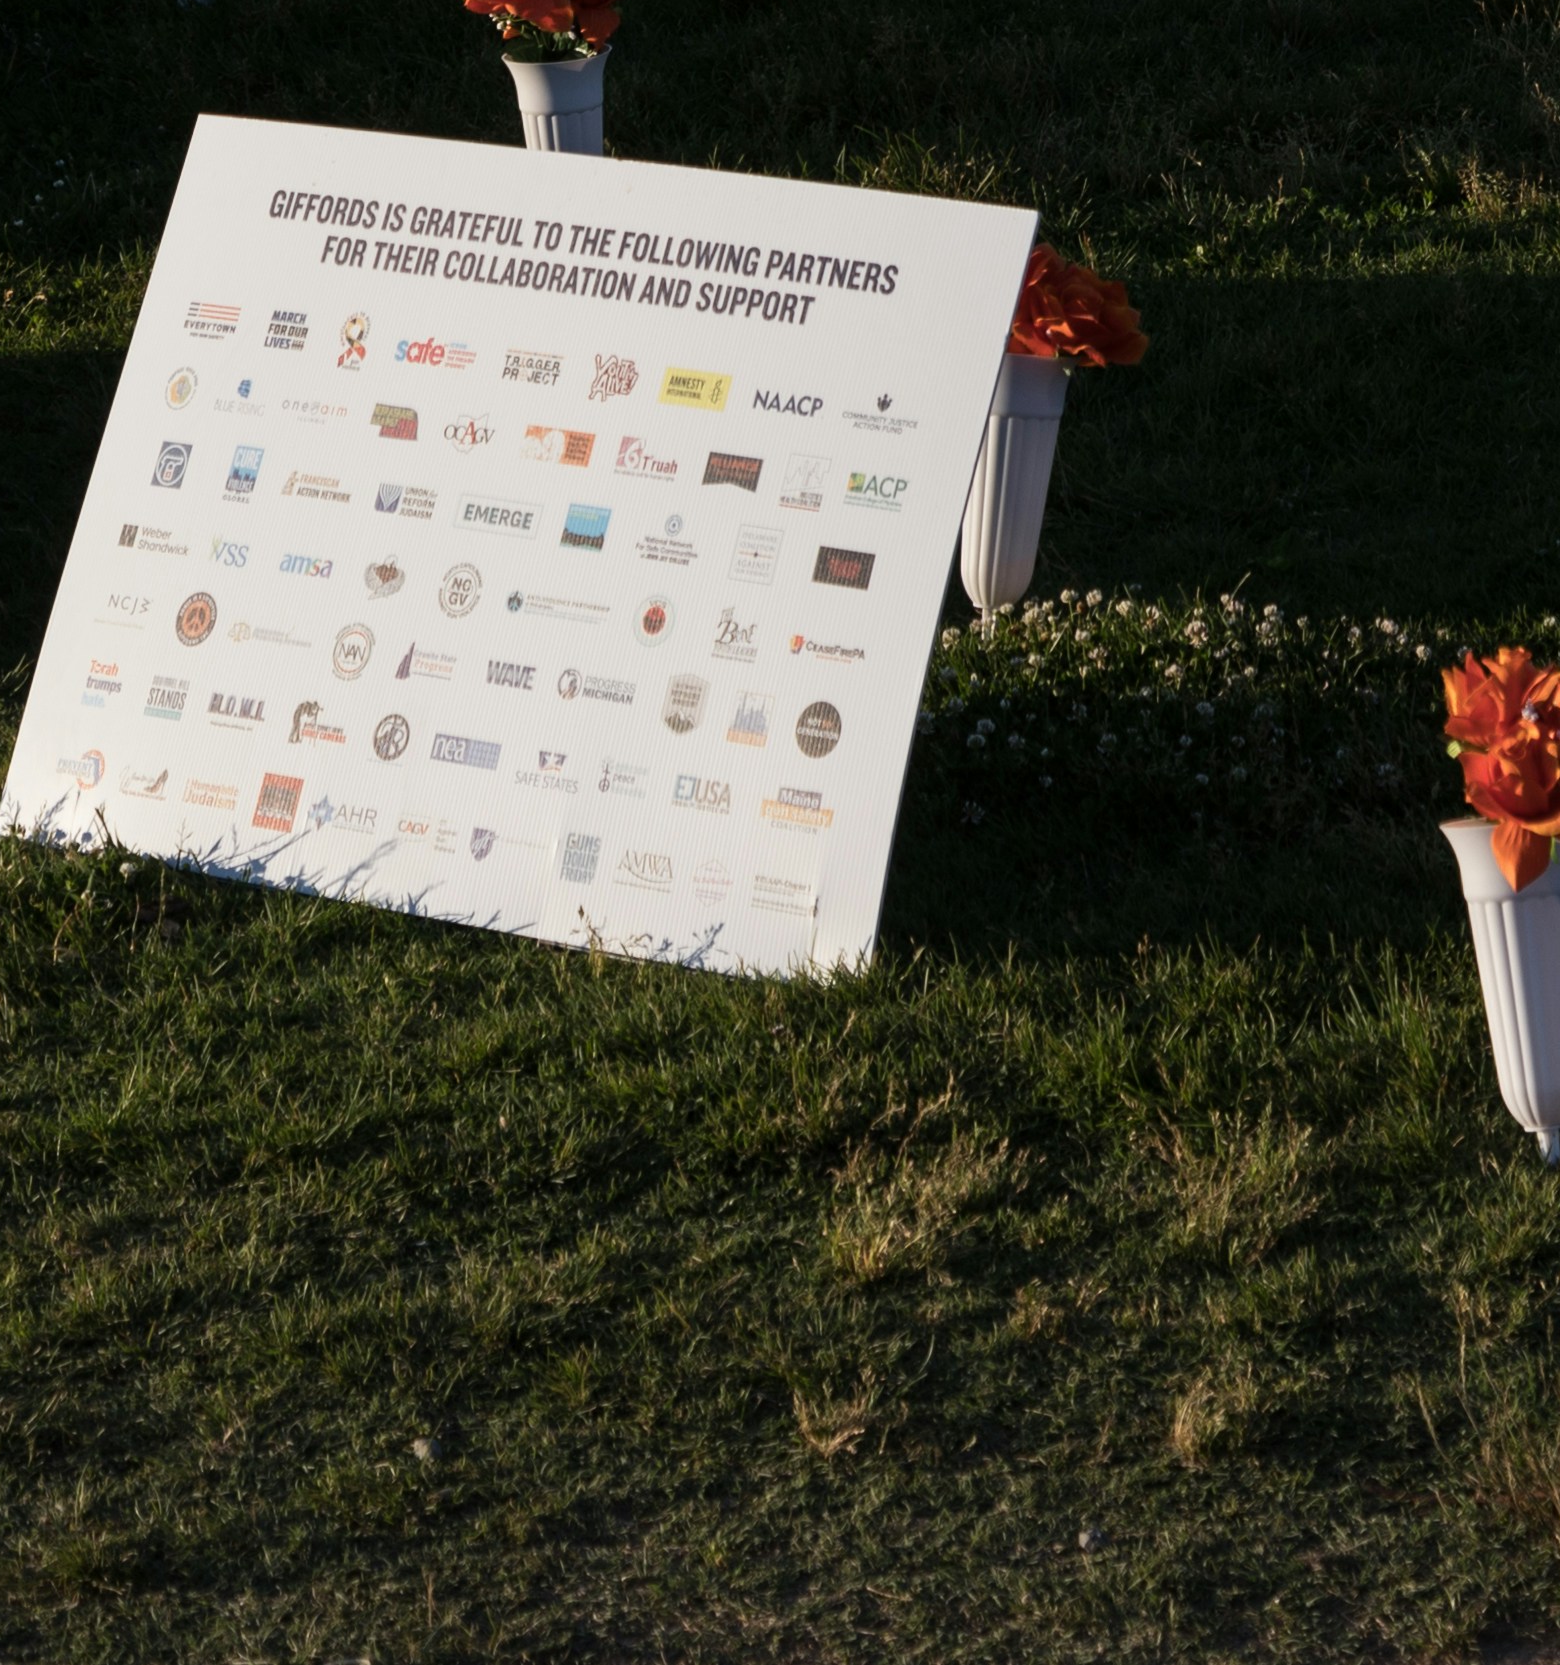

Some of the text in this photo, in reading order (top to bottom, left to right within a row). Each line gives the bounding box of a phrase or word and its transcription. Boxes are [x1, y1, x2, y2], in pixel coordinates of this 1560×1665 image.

[269, 189, 899, 296] GIFFORDS IS GRATEFUL TO THE FOLLOWING PARTNERS
[320, 235, 815, 326] FOR THEIR COLLABORATION AND SUPPORT
[183, 320, 237, 334] EVERYTOWN
[271, 310, 307, 325] MARCH
[268, 323, 308, 339] FOR OUR
[263, 336, 290, 350] LIVES
[394, 337, 445, 366] safe
[668, 375, 706, 391] AMNESTY
[752, 389, 824, 417] NAACP
[842, 411, 919, 429] COMMUNITY JUSTICE
[863, 475, 908, 499] ACP
[398, 507, 433, 521] JUDAISM
[402, 497, 436, 510] REFORM
[463, 503, 534, 530] EMERGE
[141, 526, 172, 540] Weber
[137, 540, 189, 557] Shandwick
[280, 553, 333, 579] amsa
[90, 659, 119, 677] Torah
[487, 660, 536, 690] WAVE
[146, 687, 187, 711] STANDS
[581, 687, 634, 706] MICHIGAN
[432, 738, 467, 761] nea
[514, 771, 579, 794] SAFE STATES
[334, 805, 378, 828] AHR
[566, 832, 602, 854] GUNS
[563, 849, 599, 870] DOWN
[560, 866, 596, 885] FRIDAY
